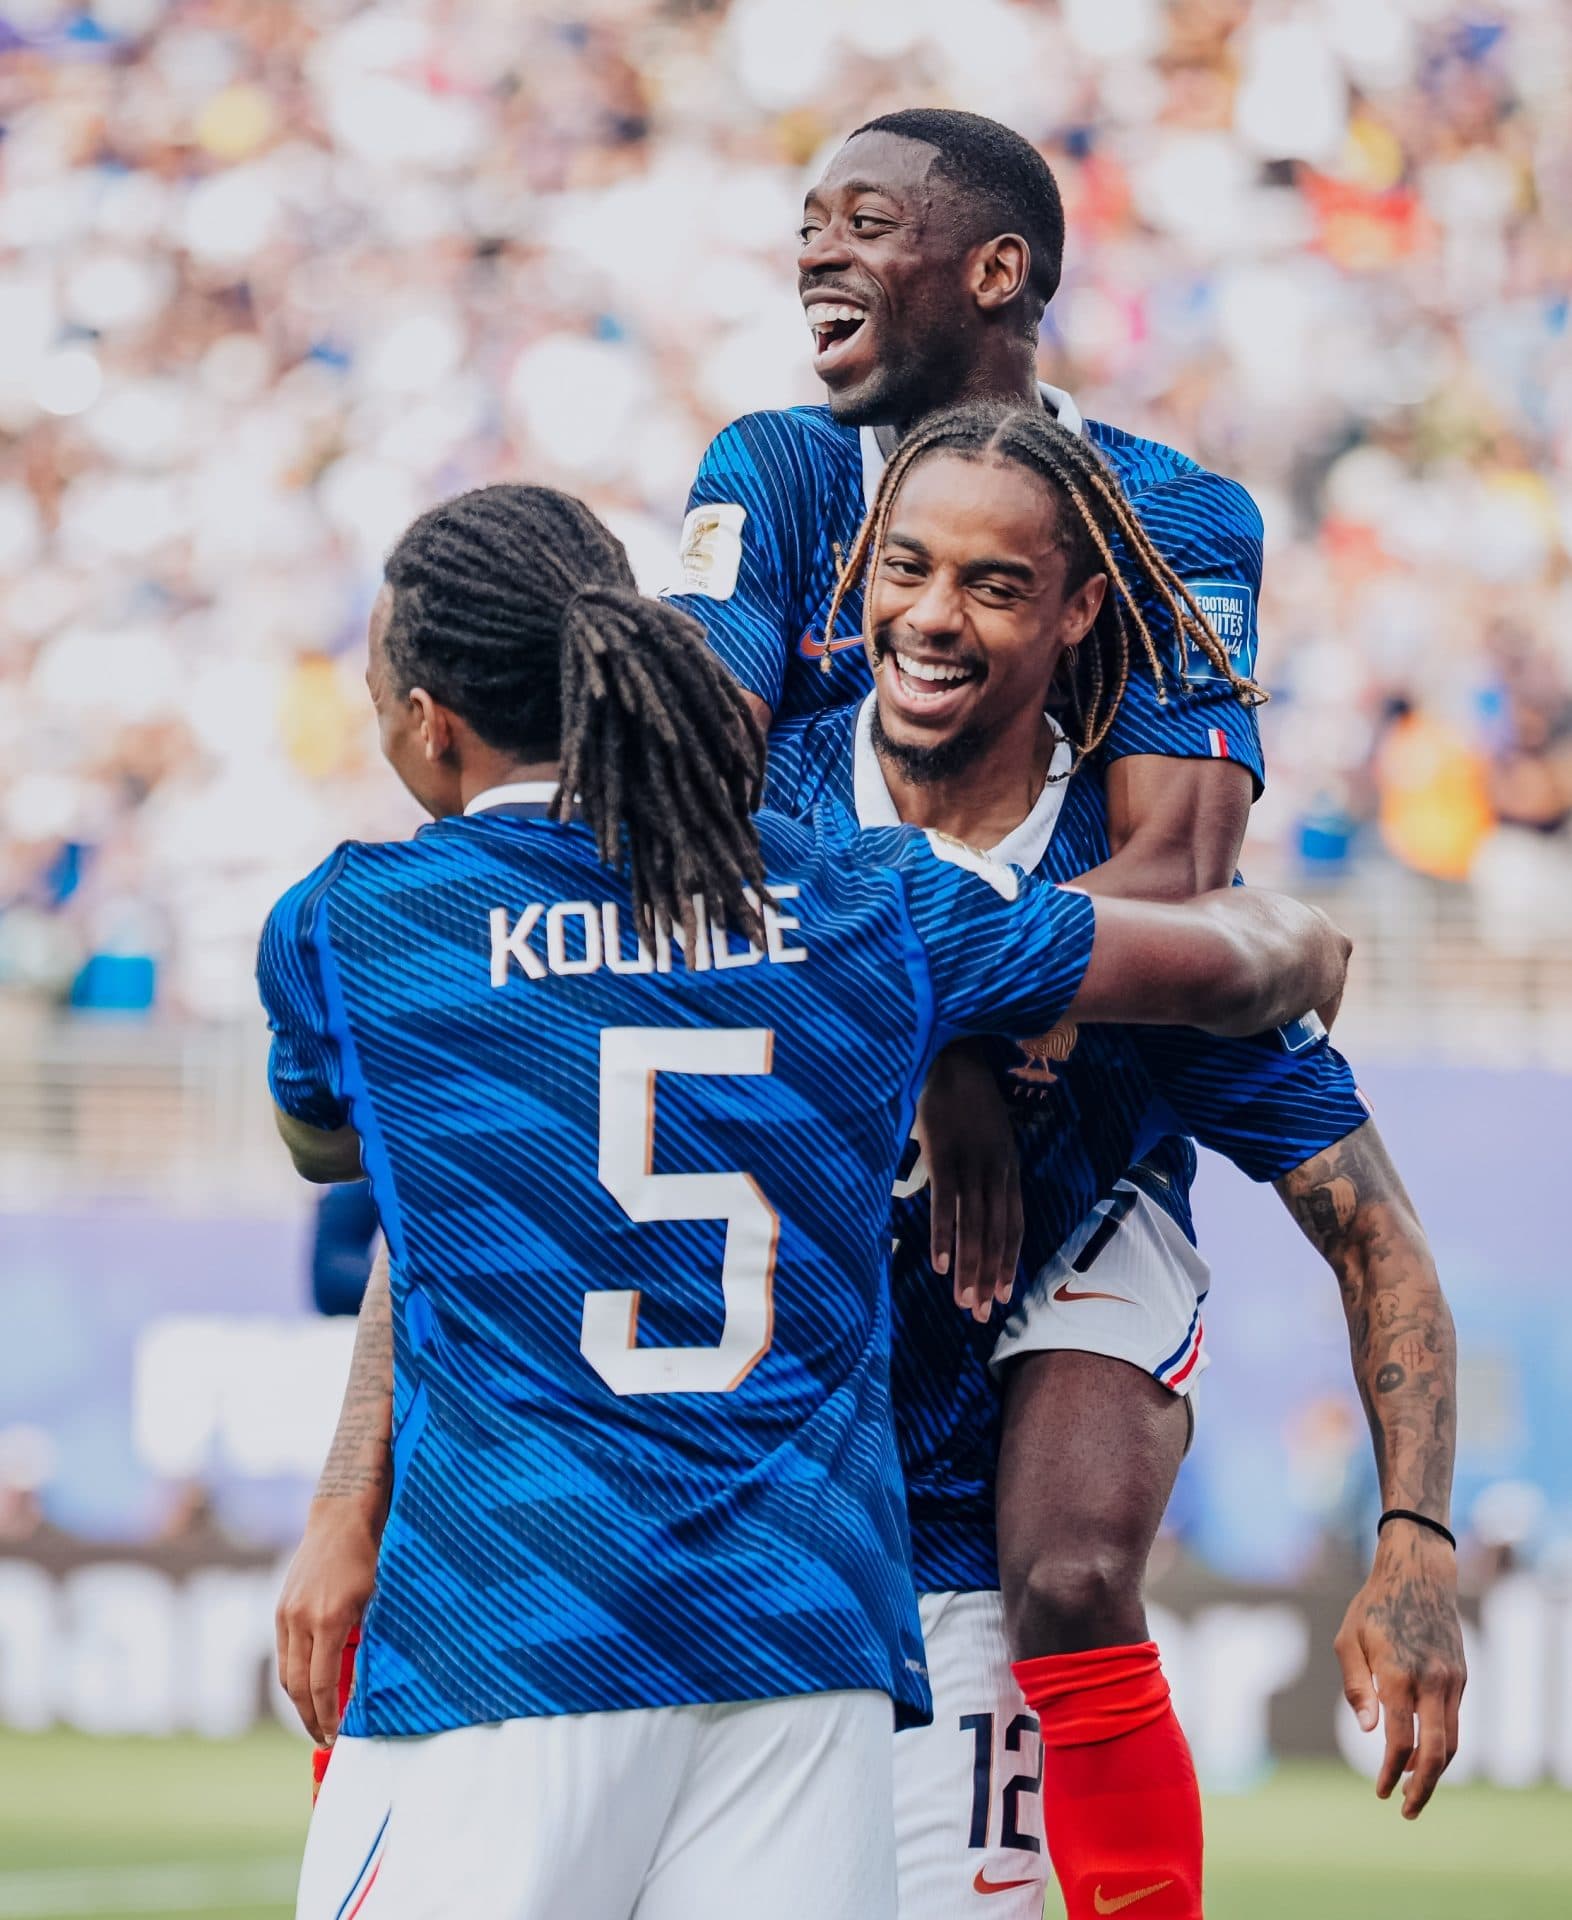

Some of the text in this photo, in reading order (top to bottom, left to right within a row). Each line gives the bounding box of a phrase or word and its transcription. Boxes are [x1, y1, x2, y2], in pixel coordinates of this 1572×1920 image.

[1196, 596, 1243, 615] FOOTBALL
[1196, 612, 1243, 637] NITES
[580, 1027, 780, 1396] 5
[959, 1712, 1044, 1854] 12
